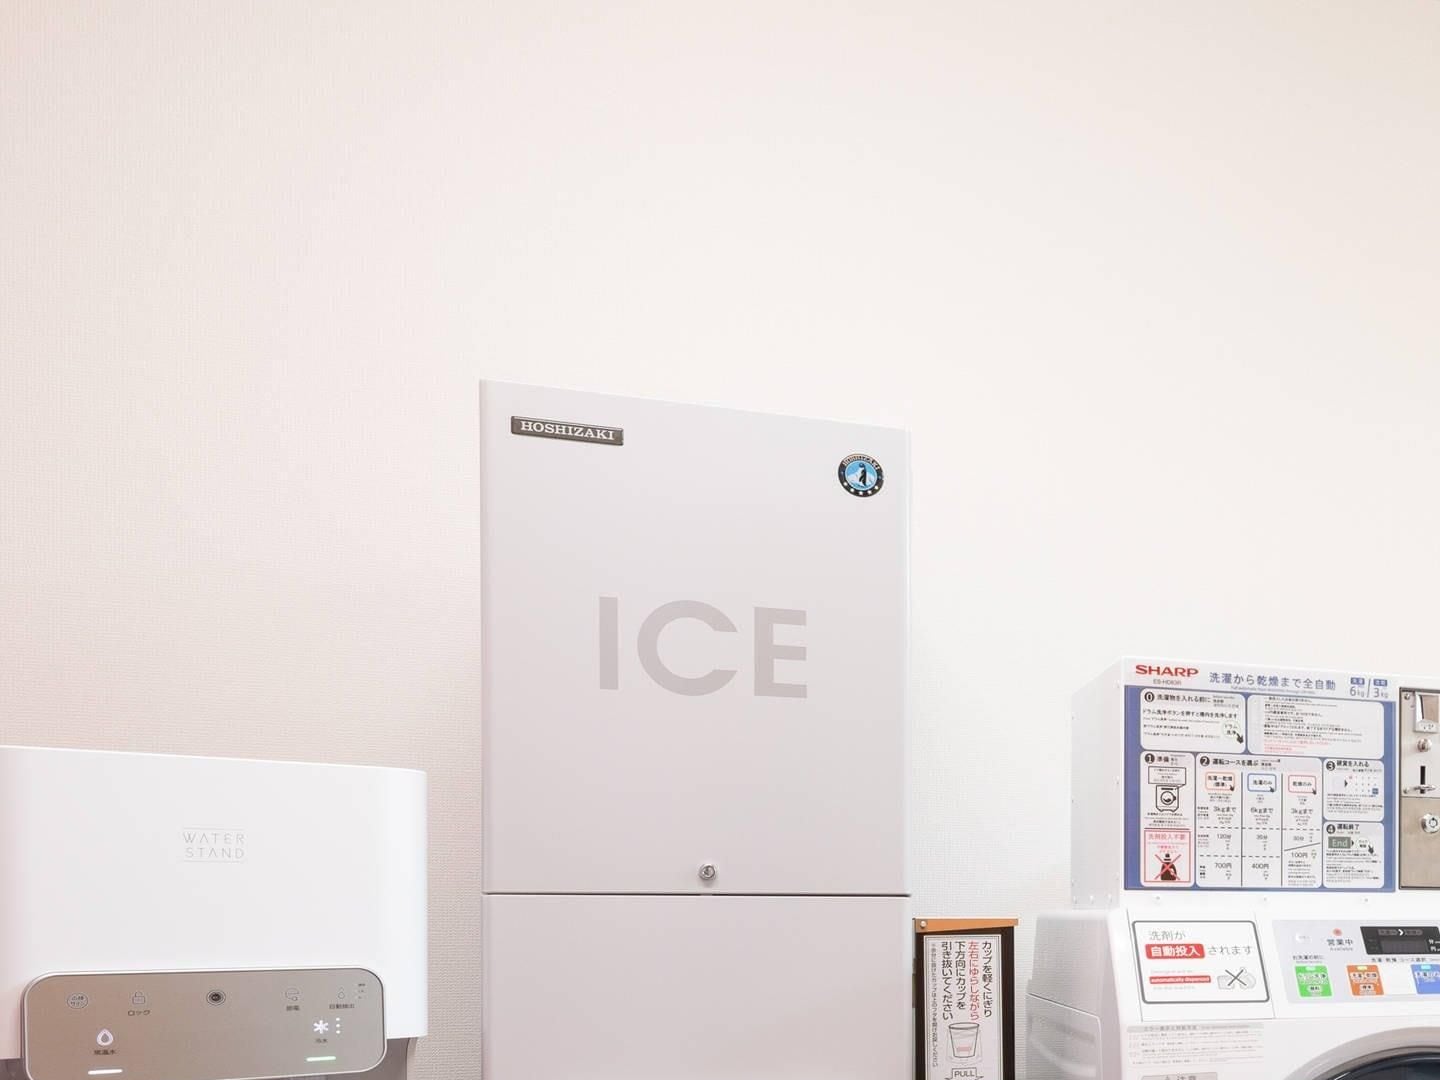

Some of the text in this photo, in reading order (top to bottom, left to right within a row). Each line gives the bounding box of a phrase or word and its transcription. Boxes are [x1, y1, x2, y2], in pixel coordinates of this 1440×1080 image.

[520, 420, 615, 441] HOSHIZAKI
[599, 596, 808, 699] ICE
[1136, 665, 1199, 678] SHARP
[1209, 672, 1336, 691] 洗濯から乾燥まで全自動
[182, 832, 245, 846] WATER
[1332, 838, 1348, 848] End
[185, 846, 245, 859] STAND
[1149, 930, 1186, 941] 洗剤が
[1151, 945, 1252, 957] 自動投入 されます
[941, 941, 953, 1020] 引き抜いてください
[954, 941, 966, 1010] 下方向にカップを
[968, 941, 980, 1020] 左右にゆらしながら
[982, 941, 993, 1017] カップを軽くにぎり
